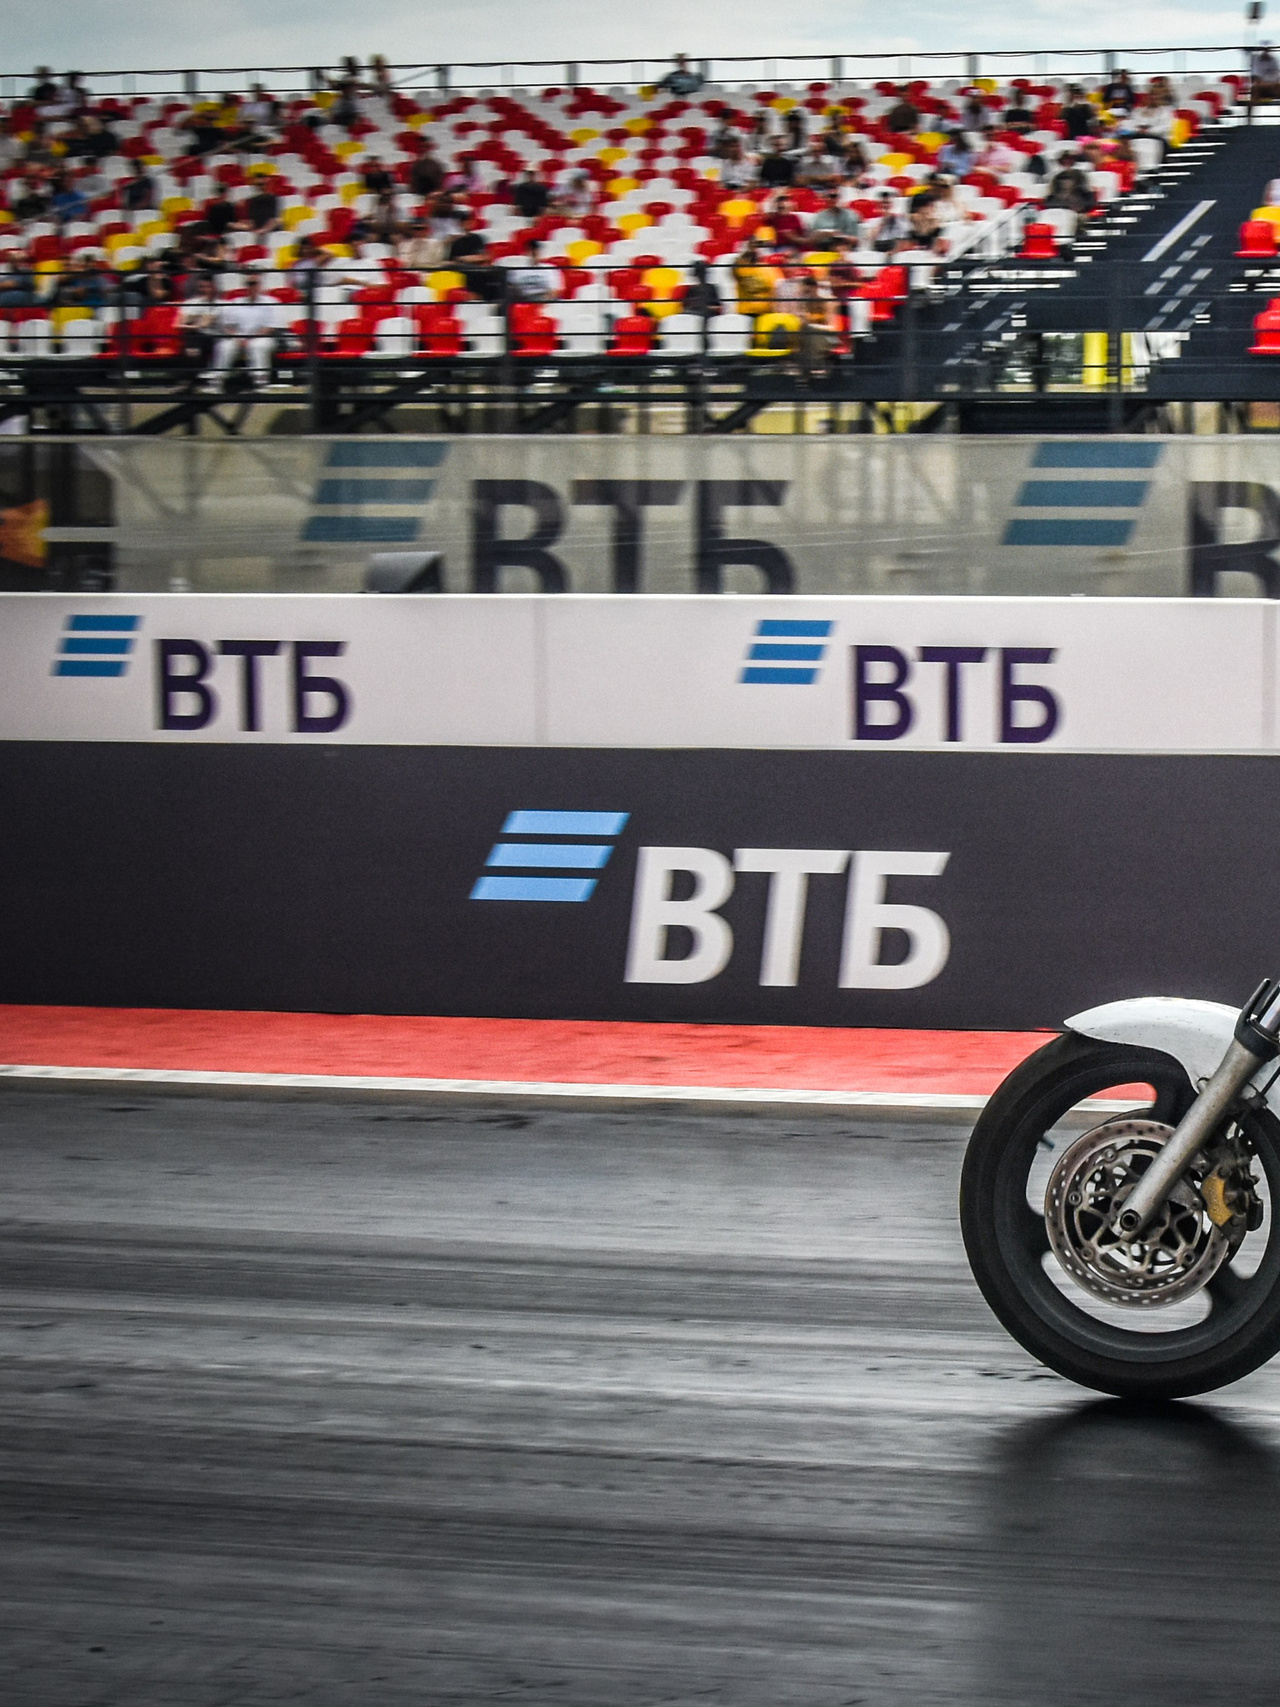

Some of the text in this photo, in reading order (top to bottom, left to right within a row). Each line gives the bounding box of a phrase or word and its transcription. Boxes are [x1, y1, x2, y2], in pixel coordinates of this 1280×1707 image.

[470, 479, 795, 594] ВТБ
[153, 638, 352, 733] ВТБ
[851, 645, 1062, 744] ВТБ
[624, 846, 951, 990] ВТБ
